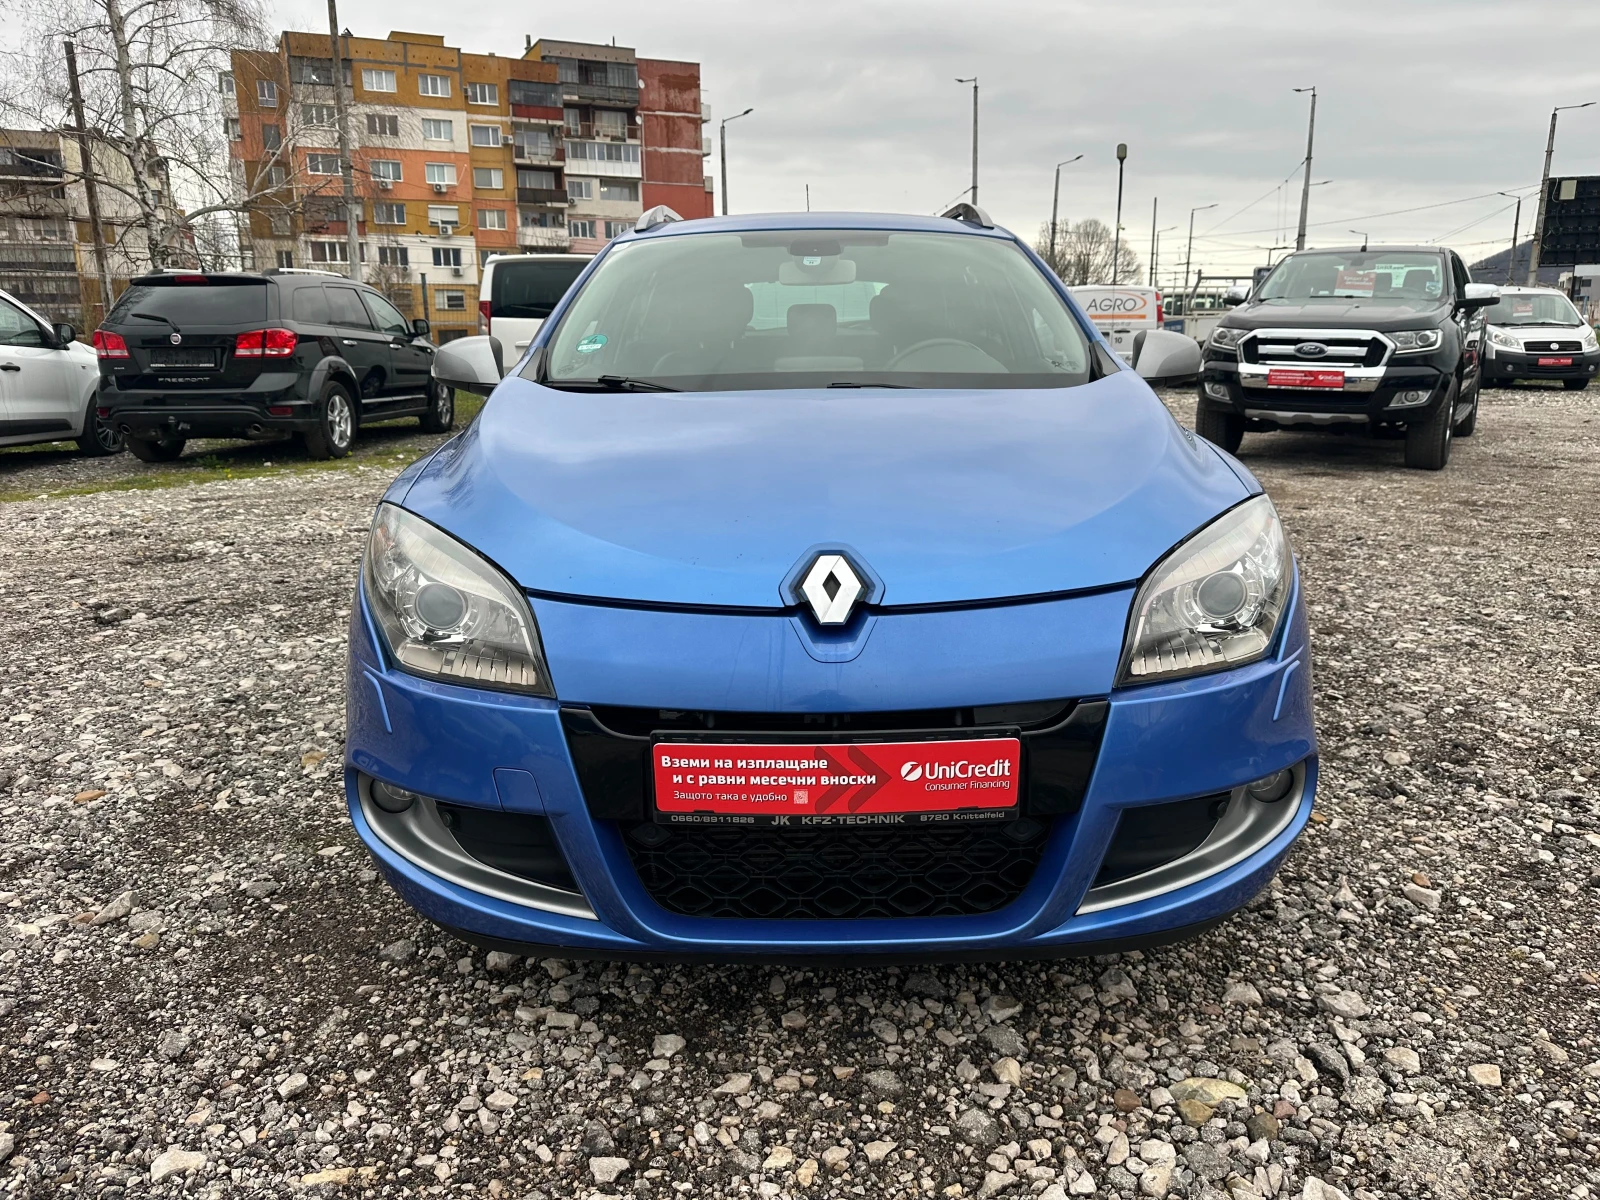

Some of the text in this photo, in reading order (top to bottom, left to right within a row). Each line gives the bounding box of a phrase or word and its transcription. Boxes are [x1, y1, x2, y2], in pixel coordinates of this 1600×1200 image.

[1086, 298, 1137, 311] AGRO
[661, 755, 828, 771] Вземи на изплащане
[925, 759, 1011, 779] UniCredit
[672, 774, 876, 786] и с равни месечни вноски
[925, 780, 1010, 791] Consumer Financing
[673, 790, 787, 803] Защото така е удобно
[671, 812, 1005, 826] 0660/8911826 JK KFZ-TECHNIK 8720 Knittelfeld
